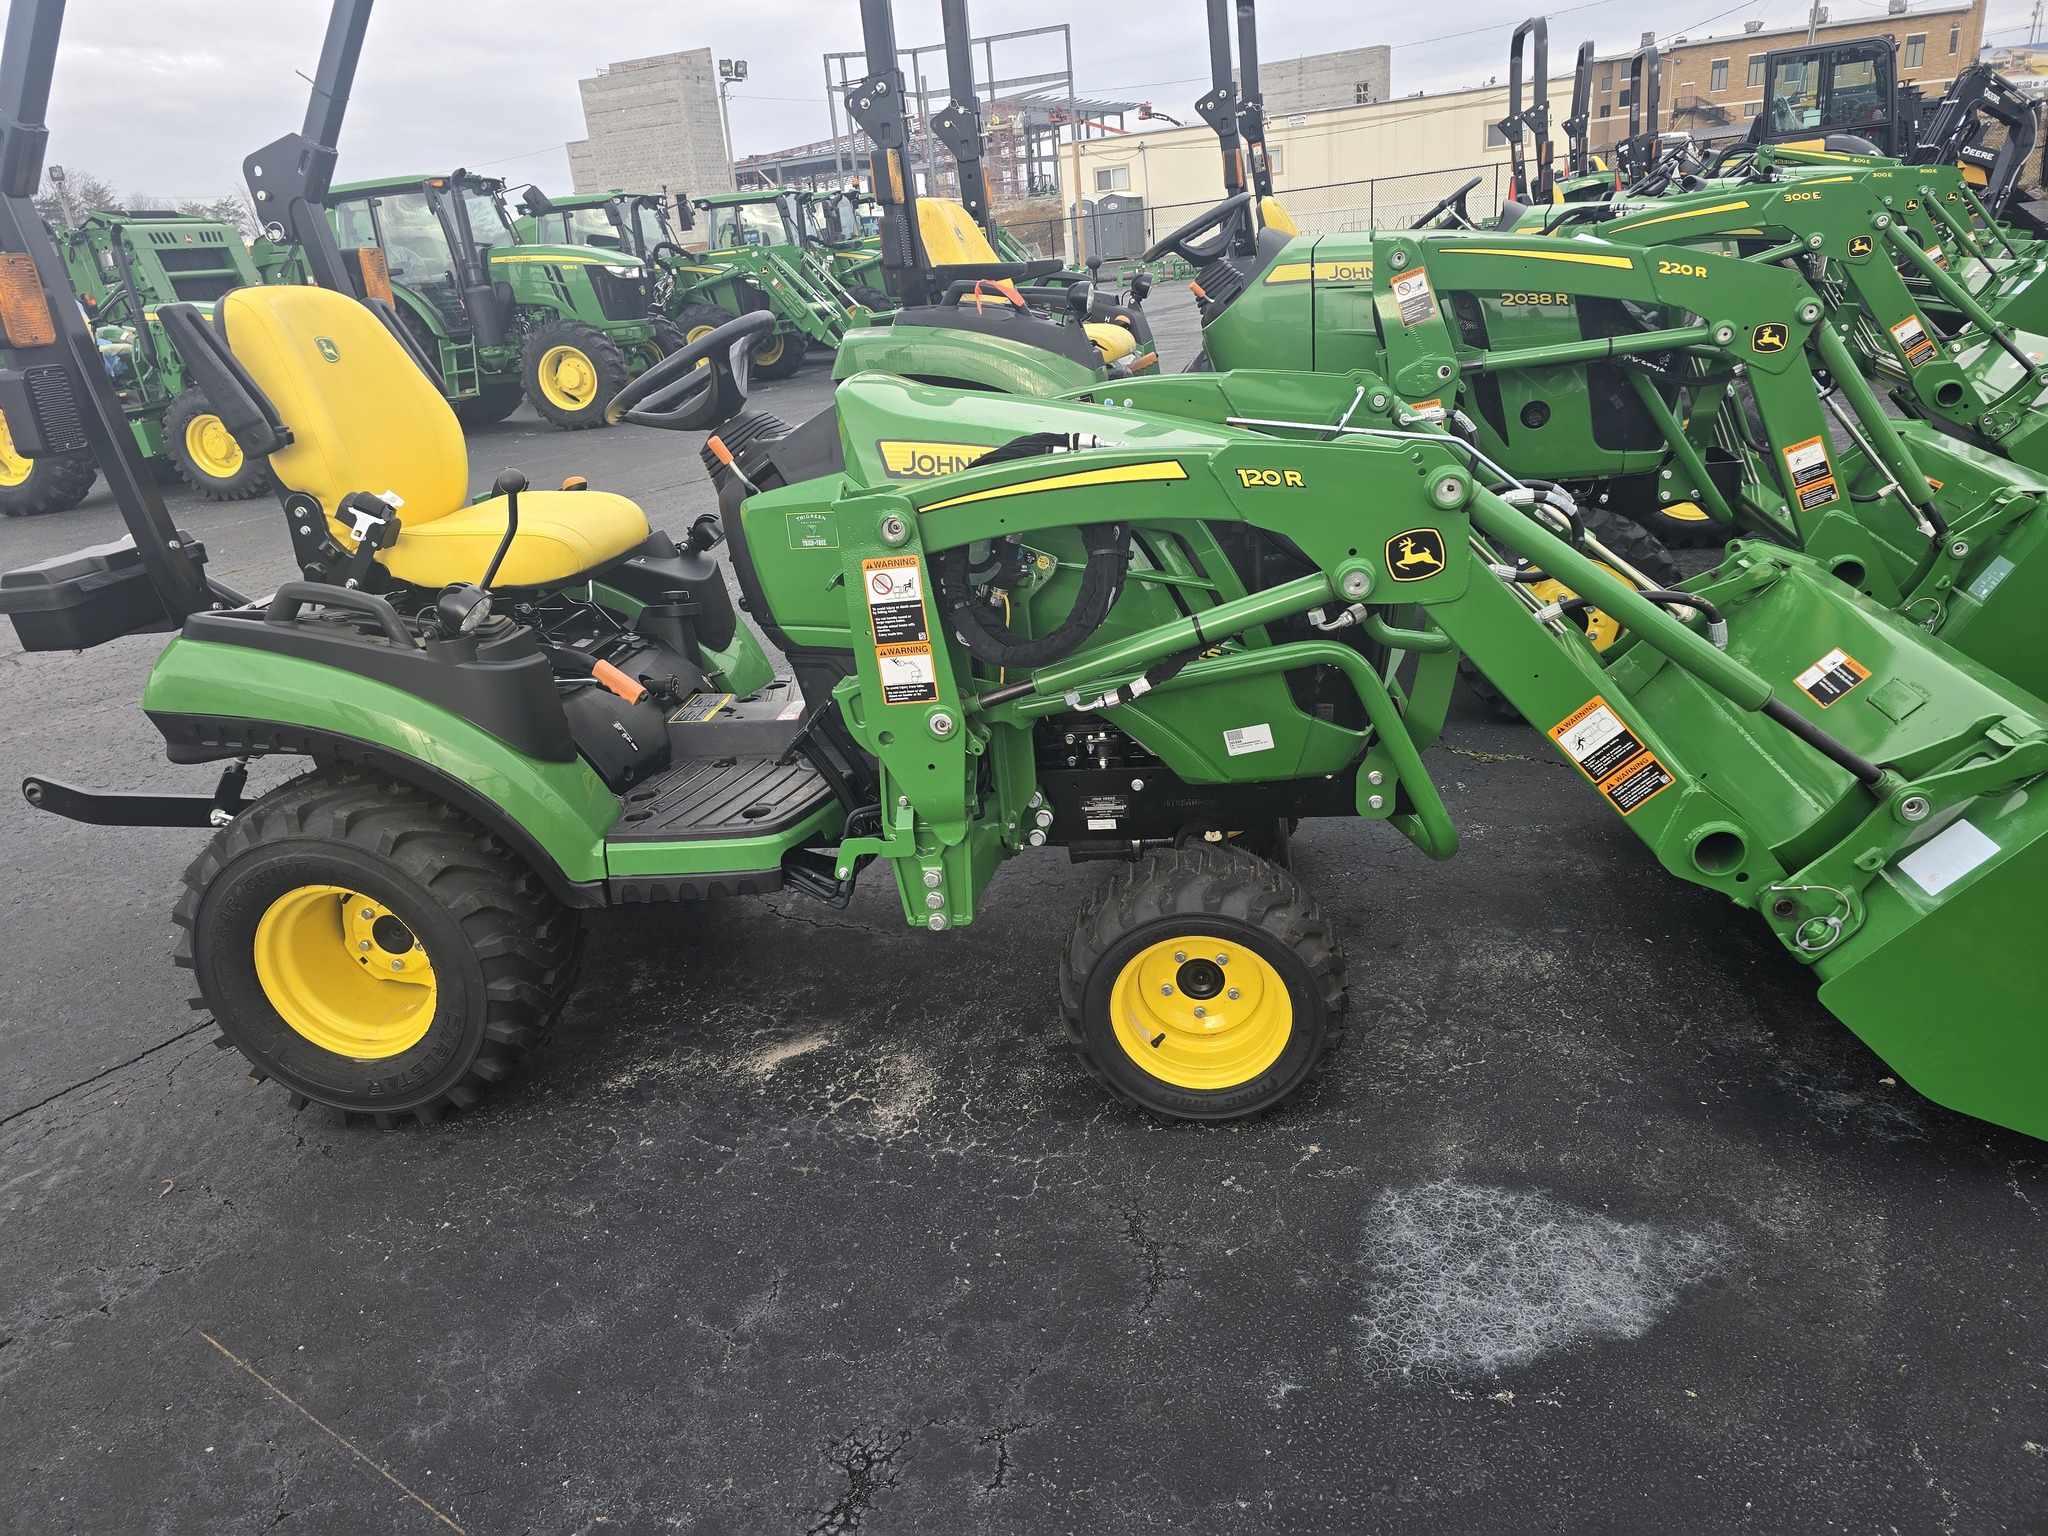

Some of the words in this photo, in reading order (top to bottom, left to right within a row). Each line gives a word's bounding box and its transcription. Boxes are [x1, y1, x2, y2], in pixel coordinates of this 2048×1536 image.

[1984, 86, 2000, 104] DEERE
[1962, 145, 1994, 160] DEERE
[1783, 193, 1811, 202] 300
[1812, 191, 1822, 200] E
[1397, 268, 1423, 281] WARNING
[1658, 260, 1693, 275] 220
[1695, 266, 1708, 279] R
[1501, 292, 1553, 306] 2038
[1555, 292, 1569, 305] R
[1412, 400, 1439, 409] WARNING
[903, 451, 971, 473] JOHN
[1236, 468, 1282, 488] 120
[1282, 469, 1306, 488] R
[873, 557, 916, 568] WARNING
[887, 645, 928, 655] WARNING
[1563, 702, 1598, 728] WARNING
[1614, 757, 1649, 783] WARNING
[244, 861, 308, 893] CHIEF
[369, 1011, 463, 1096] CARLSTAR
